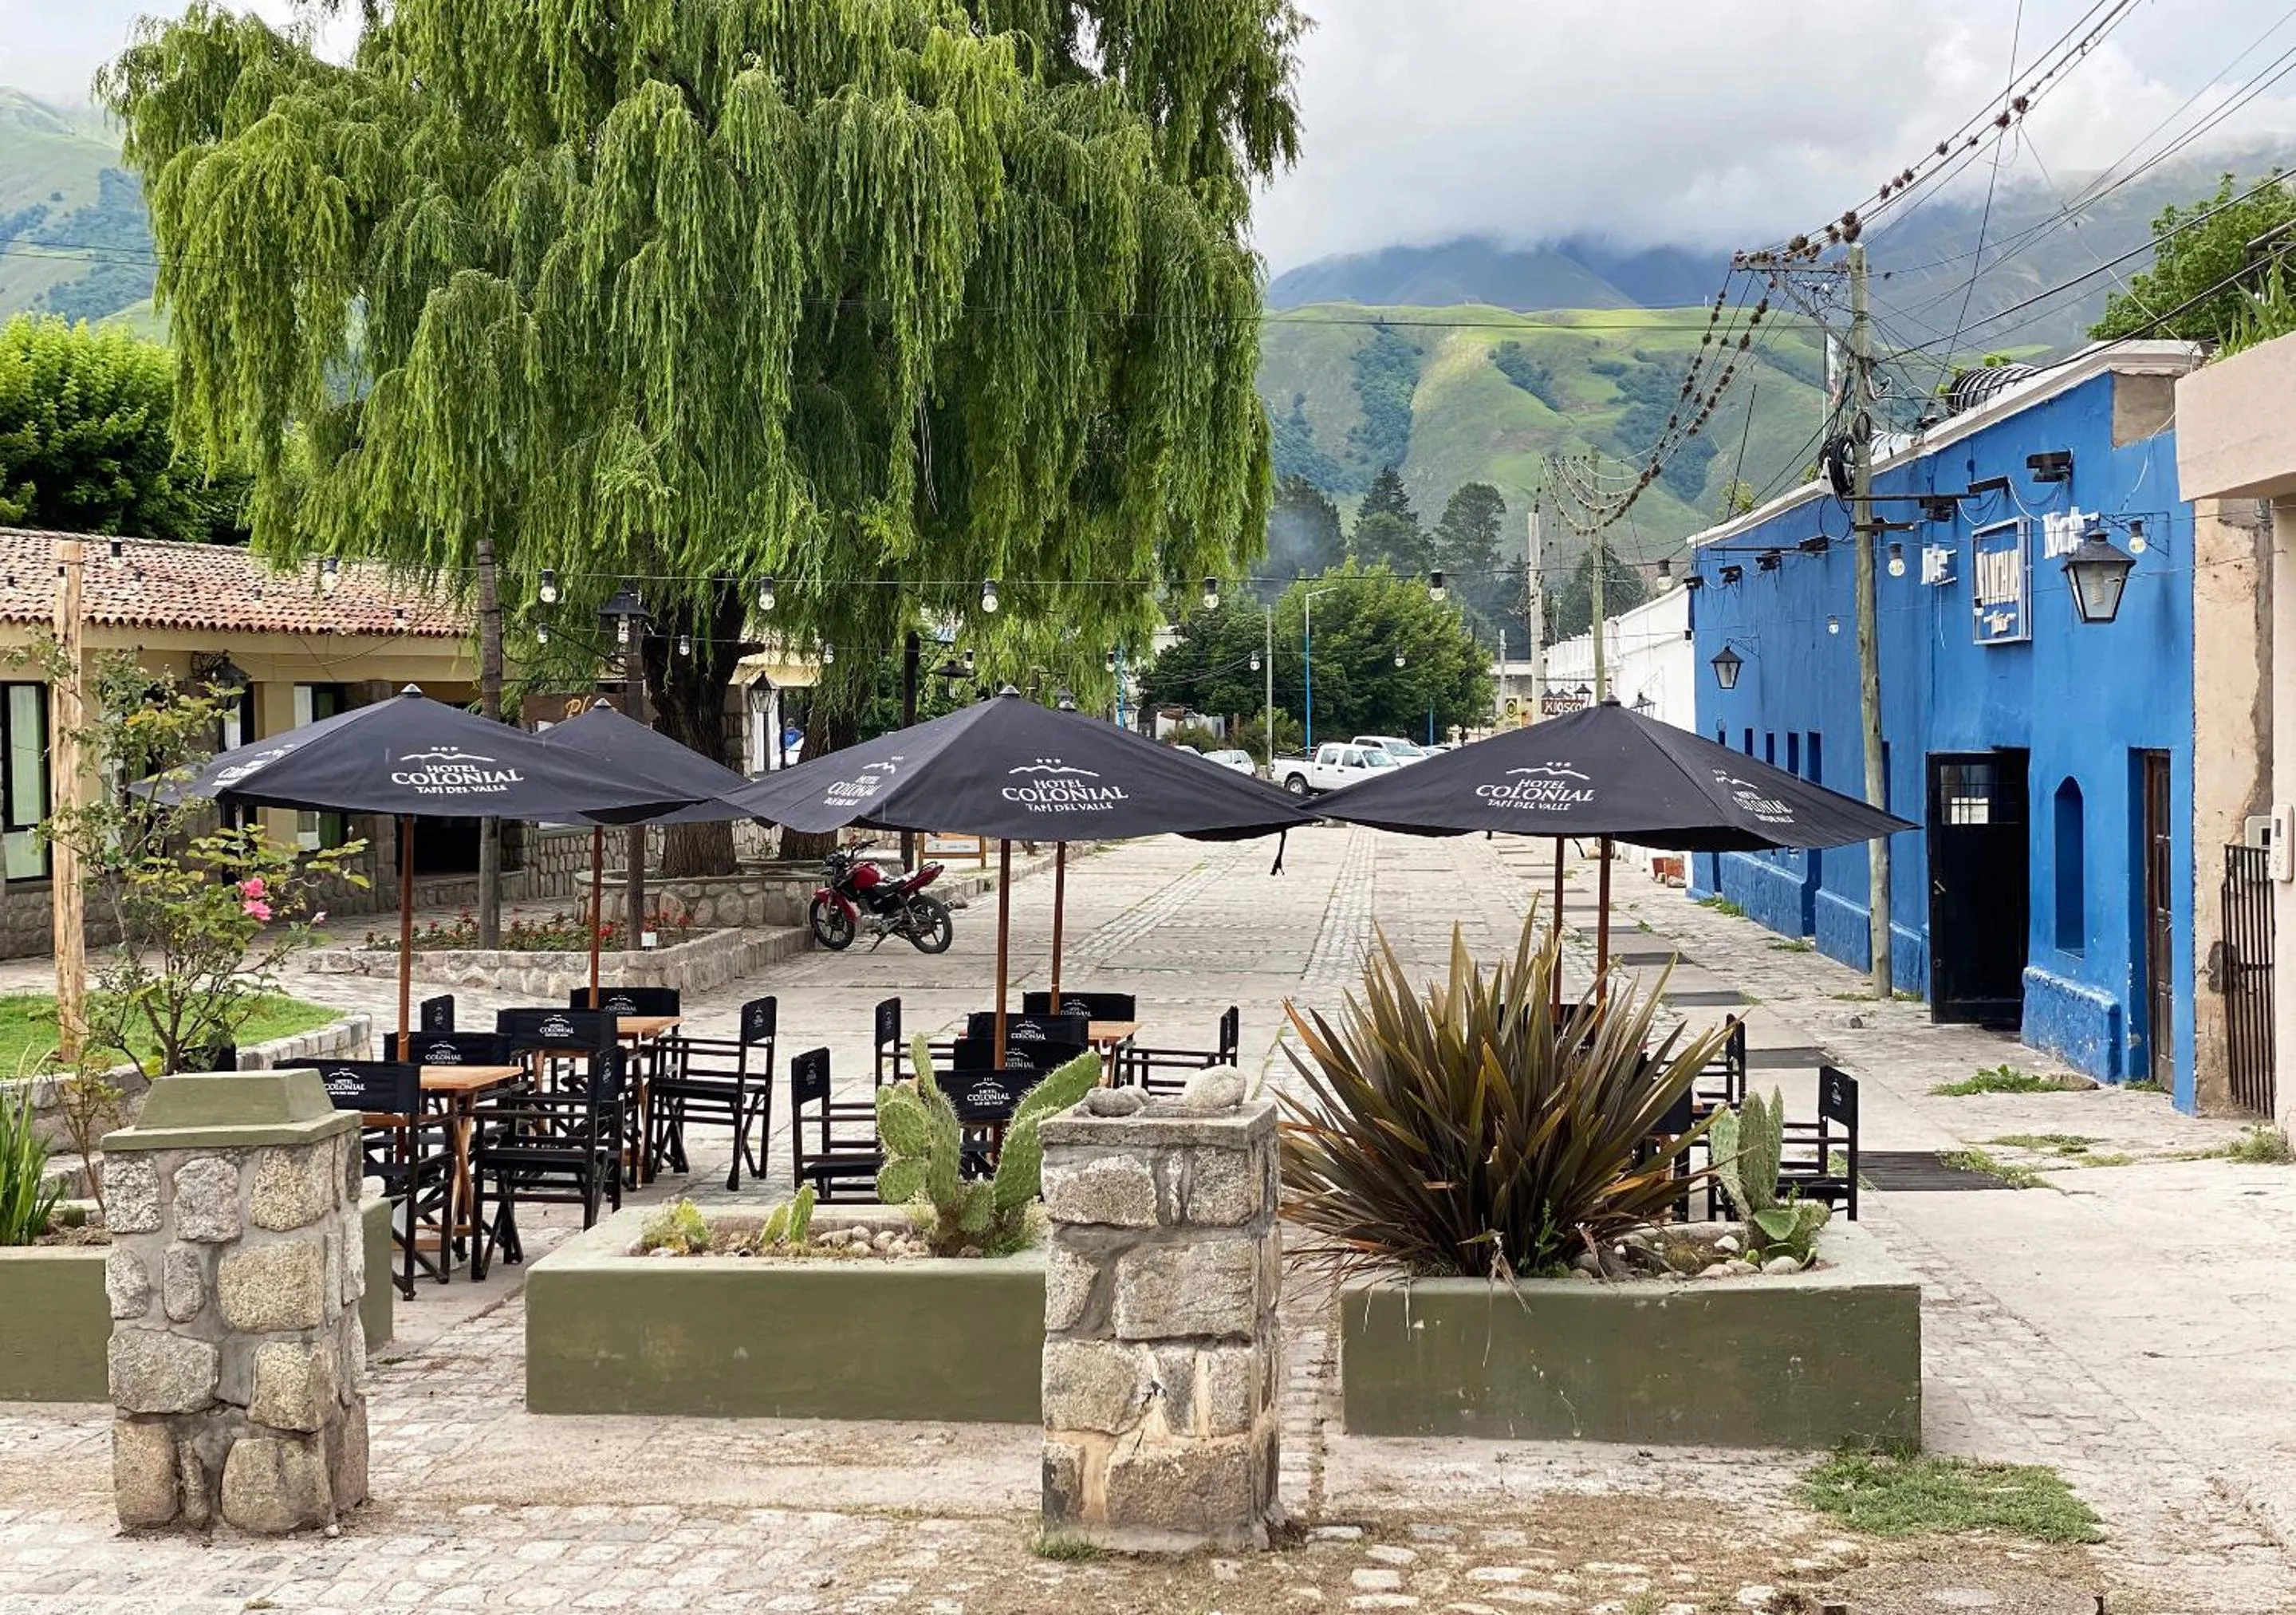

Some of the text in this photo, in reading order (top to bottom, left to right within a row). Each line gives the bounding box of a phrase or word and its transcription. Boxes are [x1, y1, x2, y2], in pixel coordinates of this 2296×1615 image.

[1544, 700, 1583, 714] KIOSCO
[425, 765, 479, 774] HOTEL
[391, 768, 524, 785] COLONIAL
[1033, 778, 1085, 789] HOTEL
[1518, 778, 1566, 790] HOTEL
[1002, 786, 1129, 802] COLONIAL
[1475, 784, 1595, 802] COLONIAL
[1053, 802, 1078, 812] DEL
[1077, 801, 1114, 811] VALLE
[1514, 801, 1535, 809] DEL
[1538, 802, 1572, 811] VALLE
[967, 1093, 1011, 1101] COLONIAL
